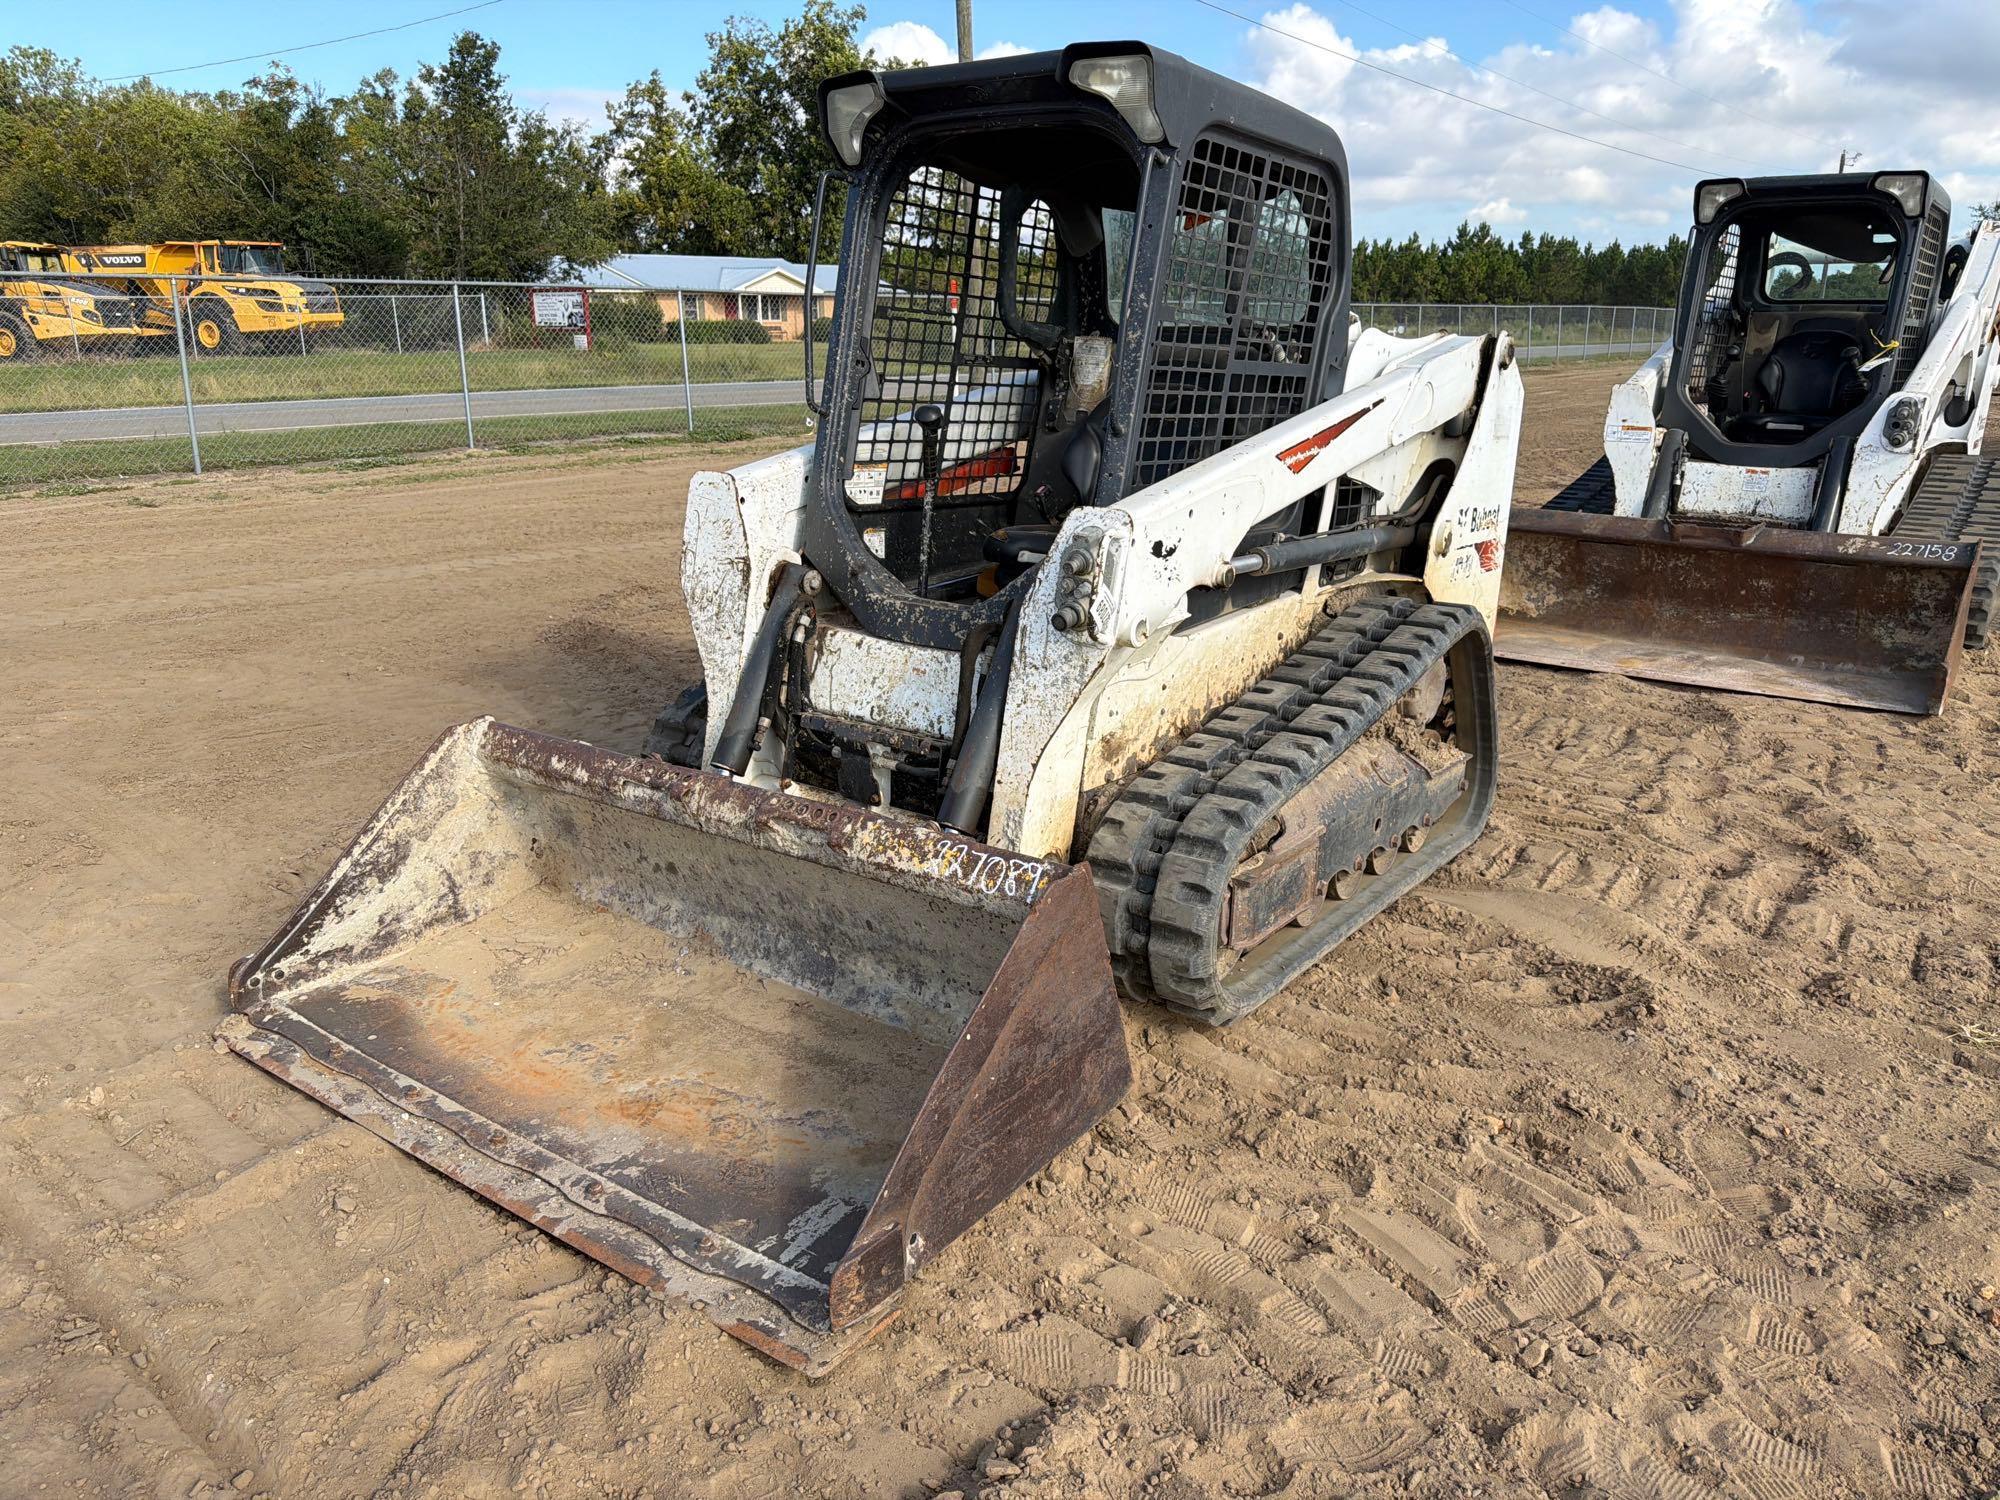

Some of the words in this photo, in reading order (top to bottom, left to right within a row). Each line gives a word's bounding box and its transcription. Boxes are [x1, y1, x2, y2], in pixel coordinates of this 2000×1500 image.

[102, 256, 142, 264] VOLVO
[1887, 542, 1958, 562] 227158
[927, 840, 1043, 904] 227089
